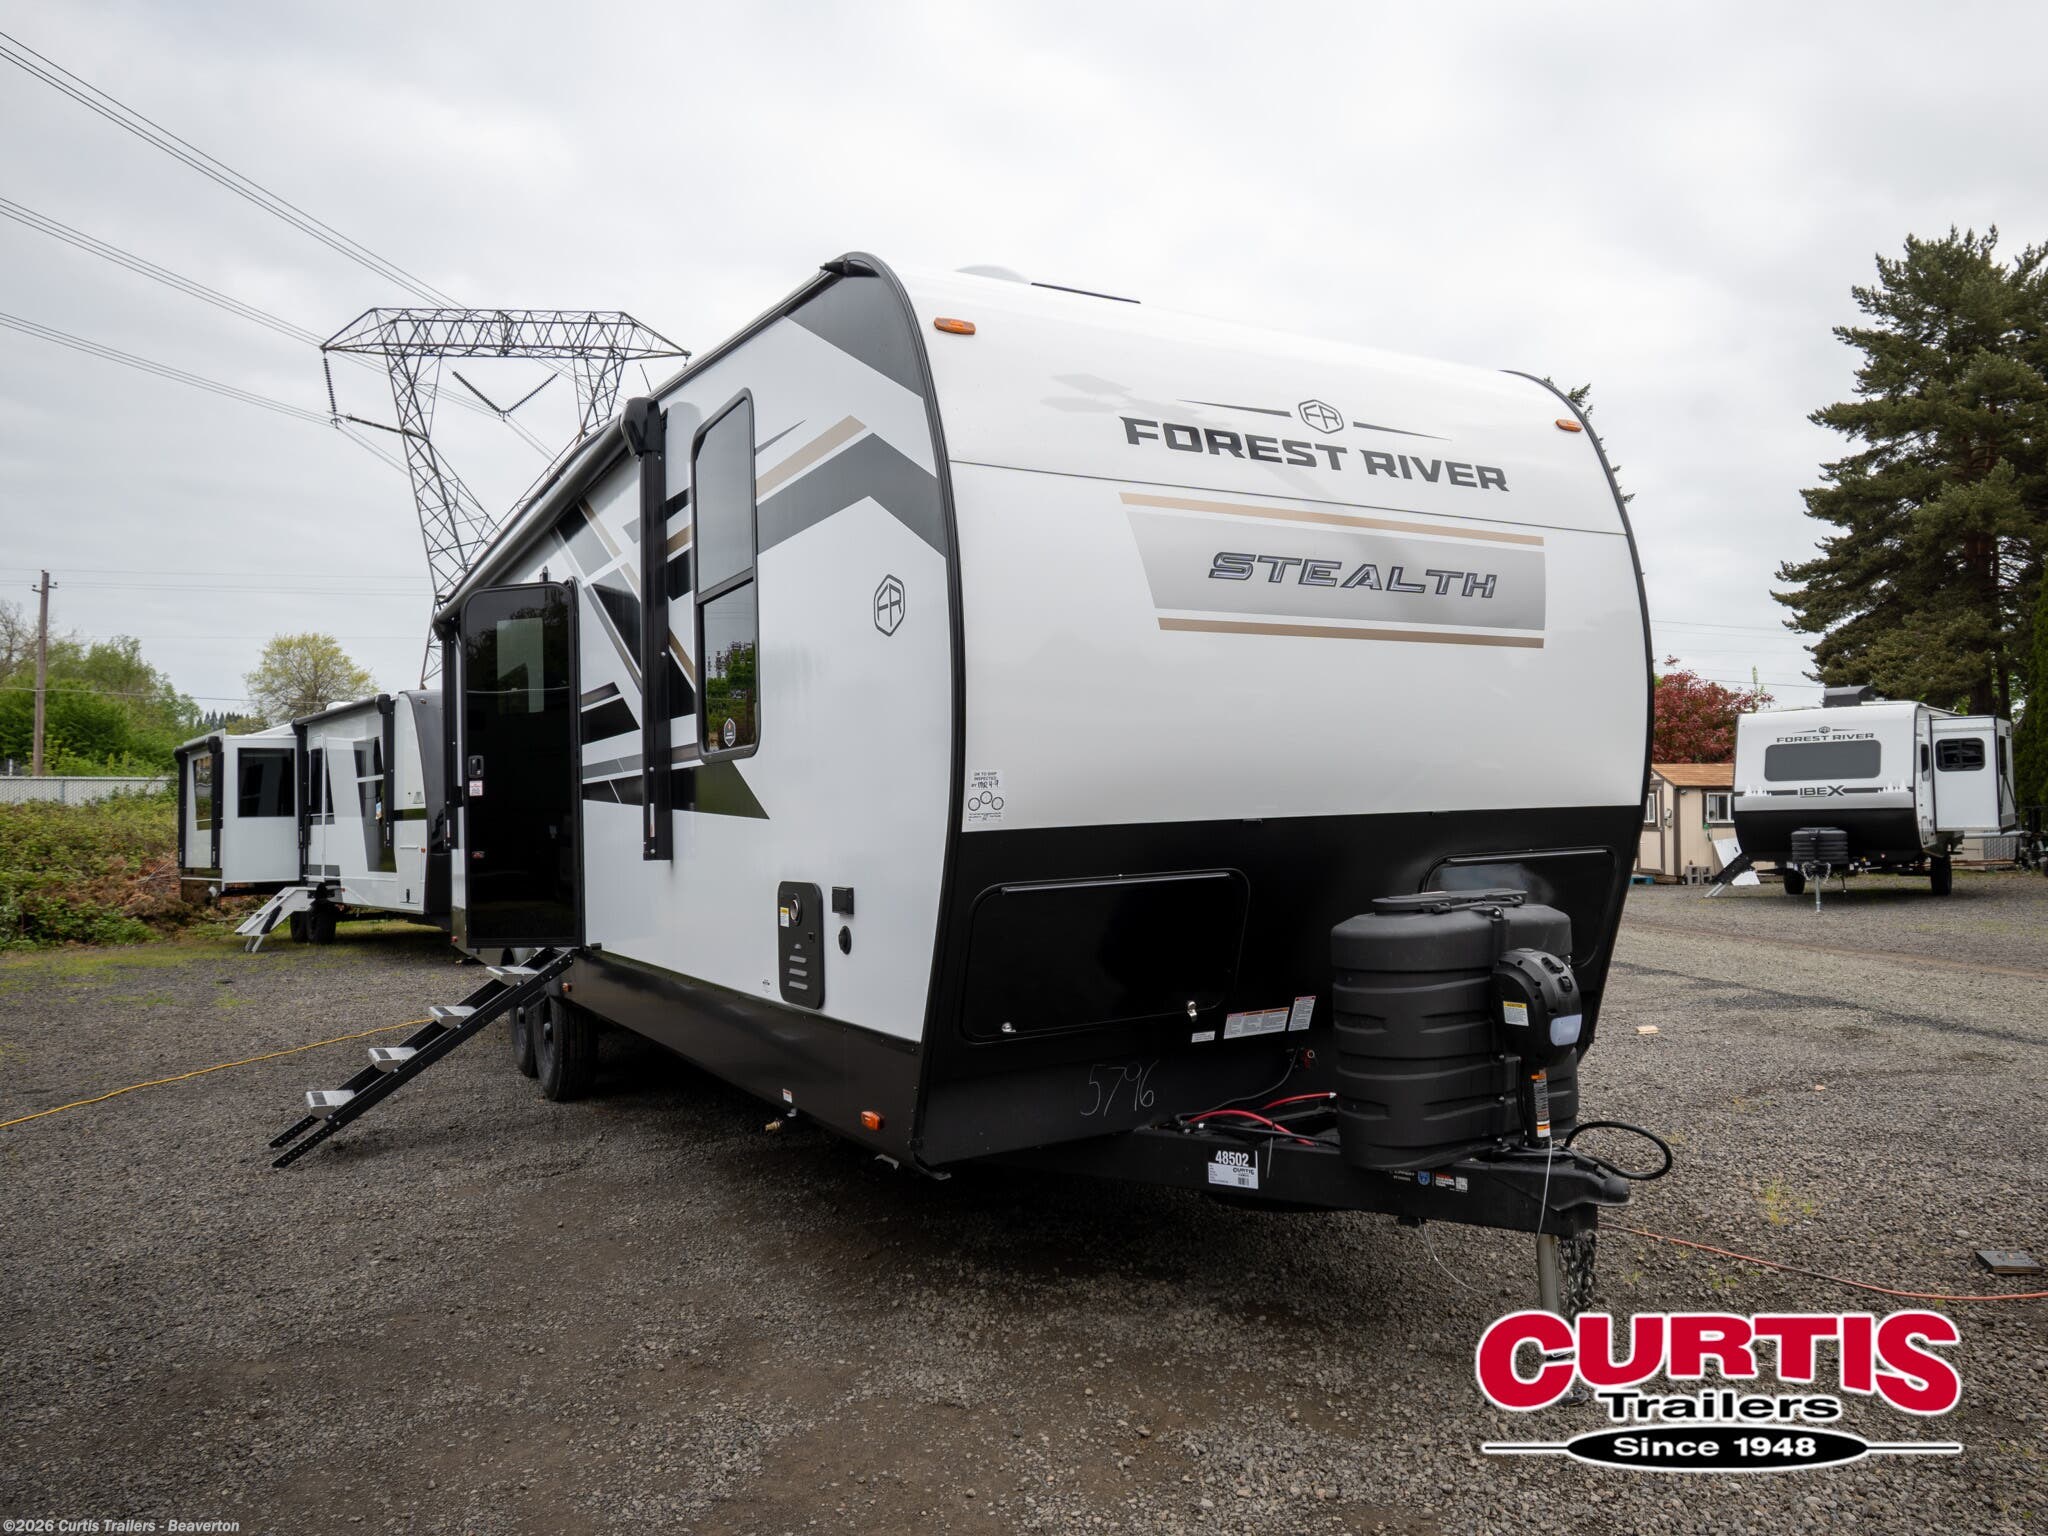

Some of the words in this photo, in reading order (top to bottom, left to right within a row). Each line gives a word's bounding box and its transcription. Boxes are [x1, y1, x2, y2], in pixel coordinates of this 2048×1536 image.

[1120, 416, 1347, 471] FOREST
[1360, 449, 1510, 492] RIVER
[1208, 551, 1498, 599] STEALTH
[1776, 735, 1829, 743] FOREST
[1832, 733, 1875, 741] RIVER
[1800, 785, 1844, 797] IBEX
[1080, 1060, 1159, 1117] 5796
[1215, 1150, 1249, 1167] 48502
